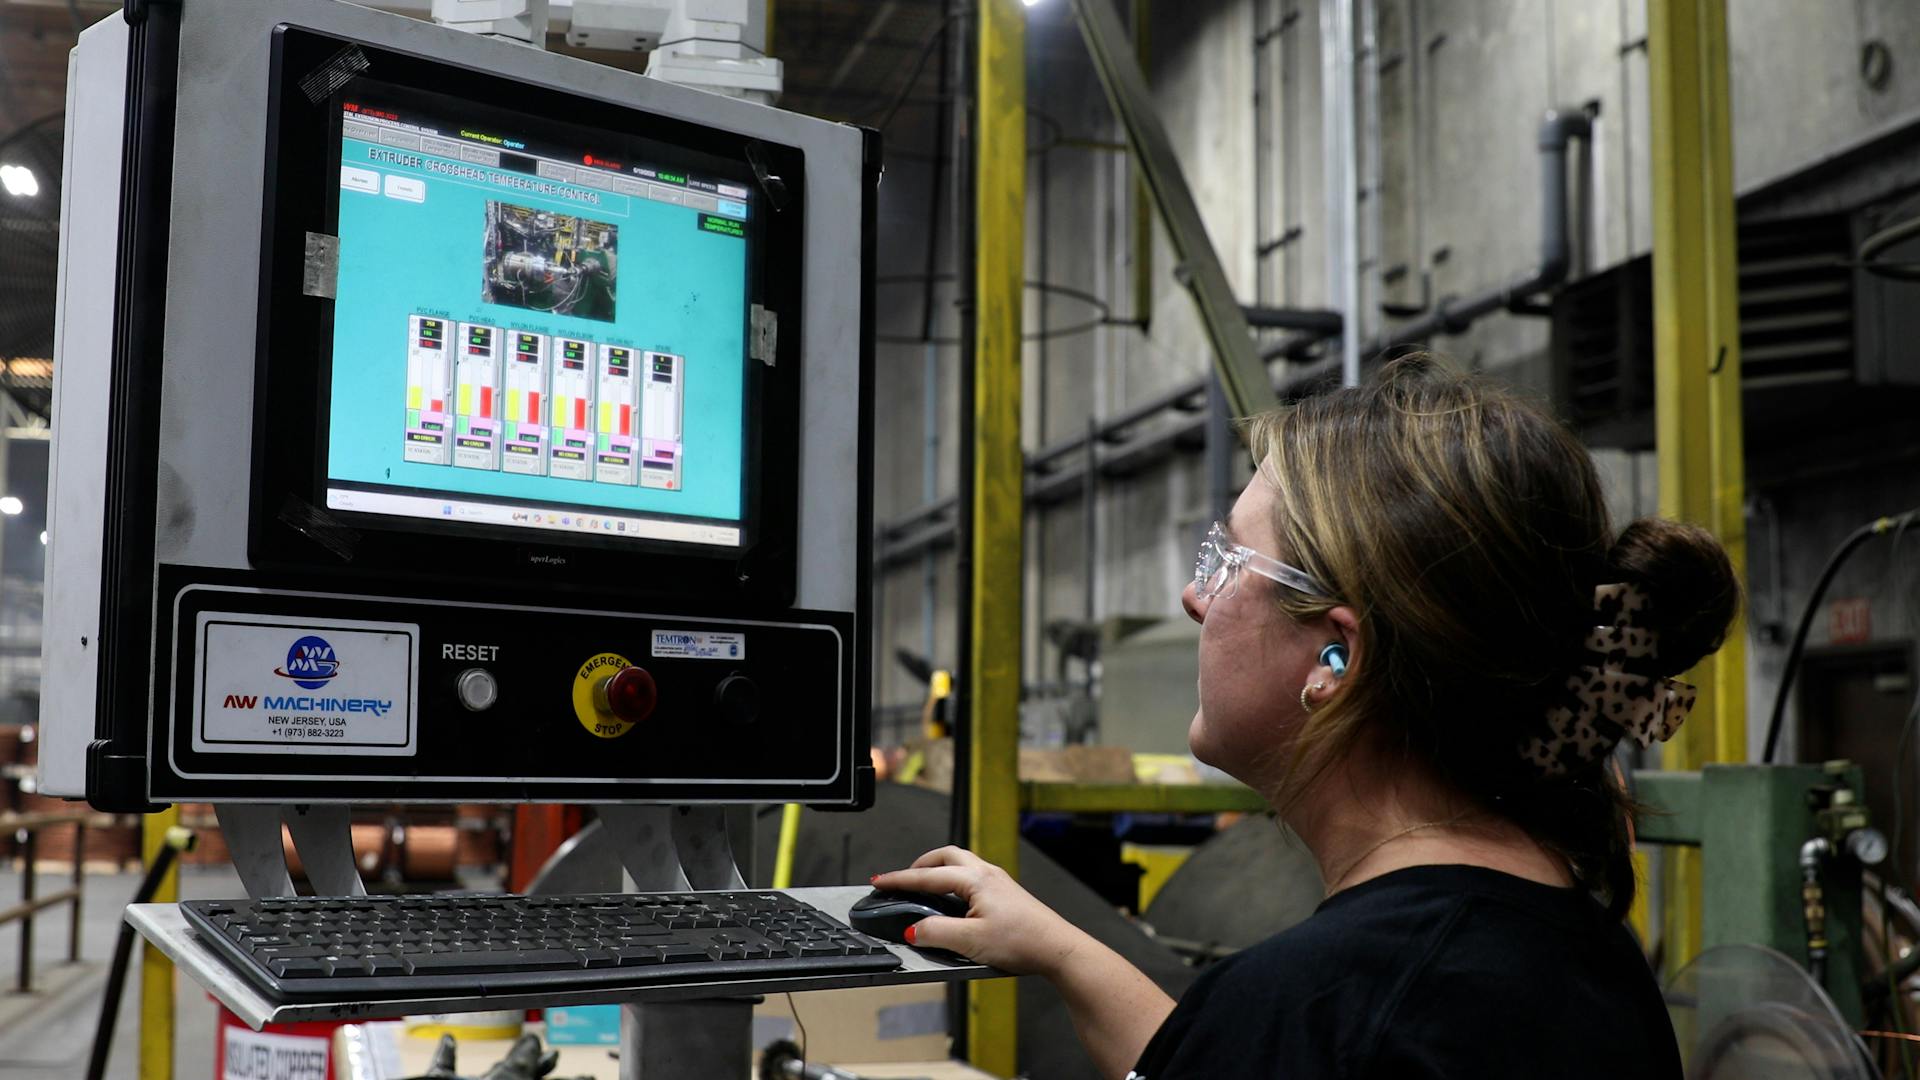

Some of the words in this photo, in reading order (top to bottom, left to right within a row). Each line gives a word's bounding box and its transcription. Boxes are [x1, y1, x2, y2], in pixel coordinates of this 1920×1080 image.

[461, 129, 481, 138] Current
[503, 139, 525, 149] Operator
[368, 147, 423, 168] EXTRUDER
[425, 159, 485, 181] CROSSHEAD
[488, 172, 557, 195] TEMPERATURE
[556, 186, 601, 205] CONTROL
[656, 634, 697, 644] TEMTRON
[442, 643, 500, 661] RESET
[580, 656, 634, 680] EMERGEN
[268, 716, 289, 725] NEW
[291, 717, 326, 727] JERSEY,
[329, 718, 346, 726] USA
[272, 728, 282, 736] +1
[284, 728, 306, 737] (973)
[307, 729, 344, 737] 882-3223
[594, 723, 623, 735] STOP
